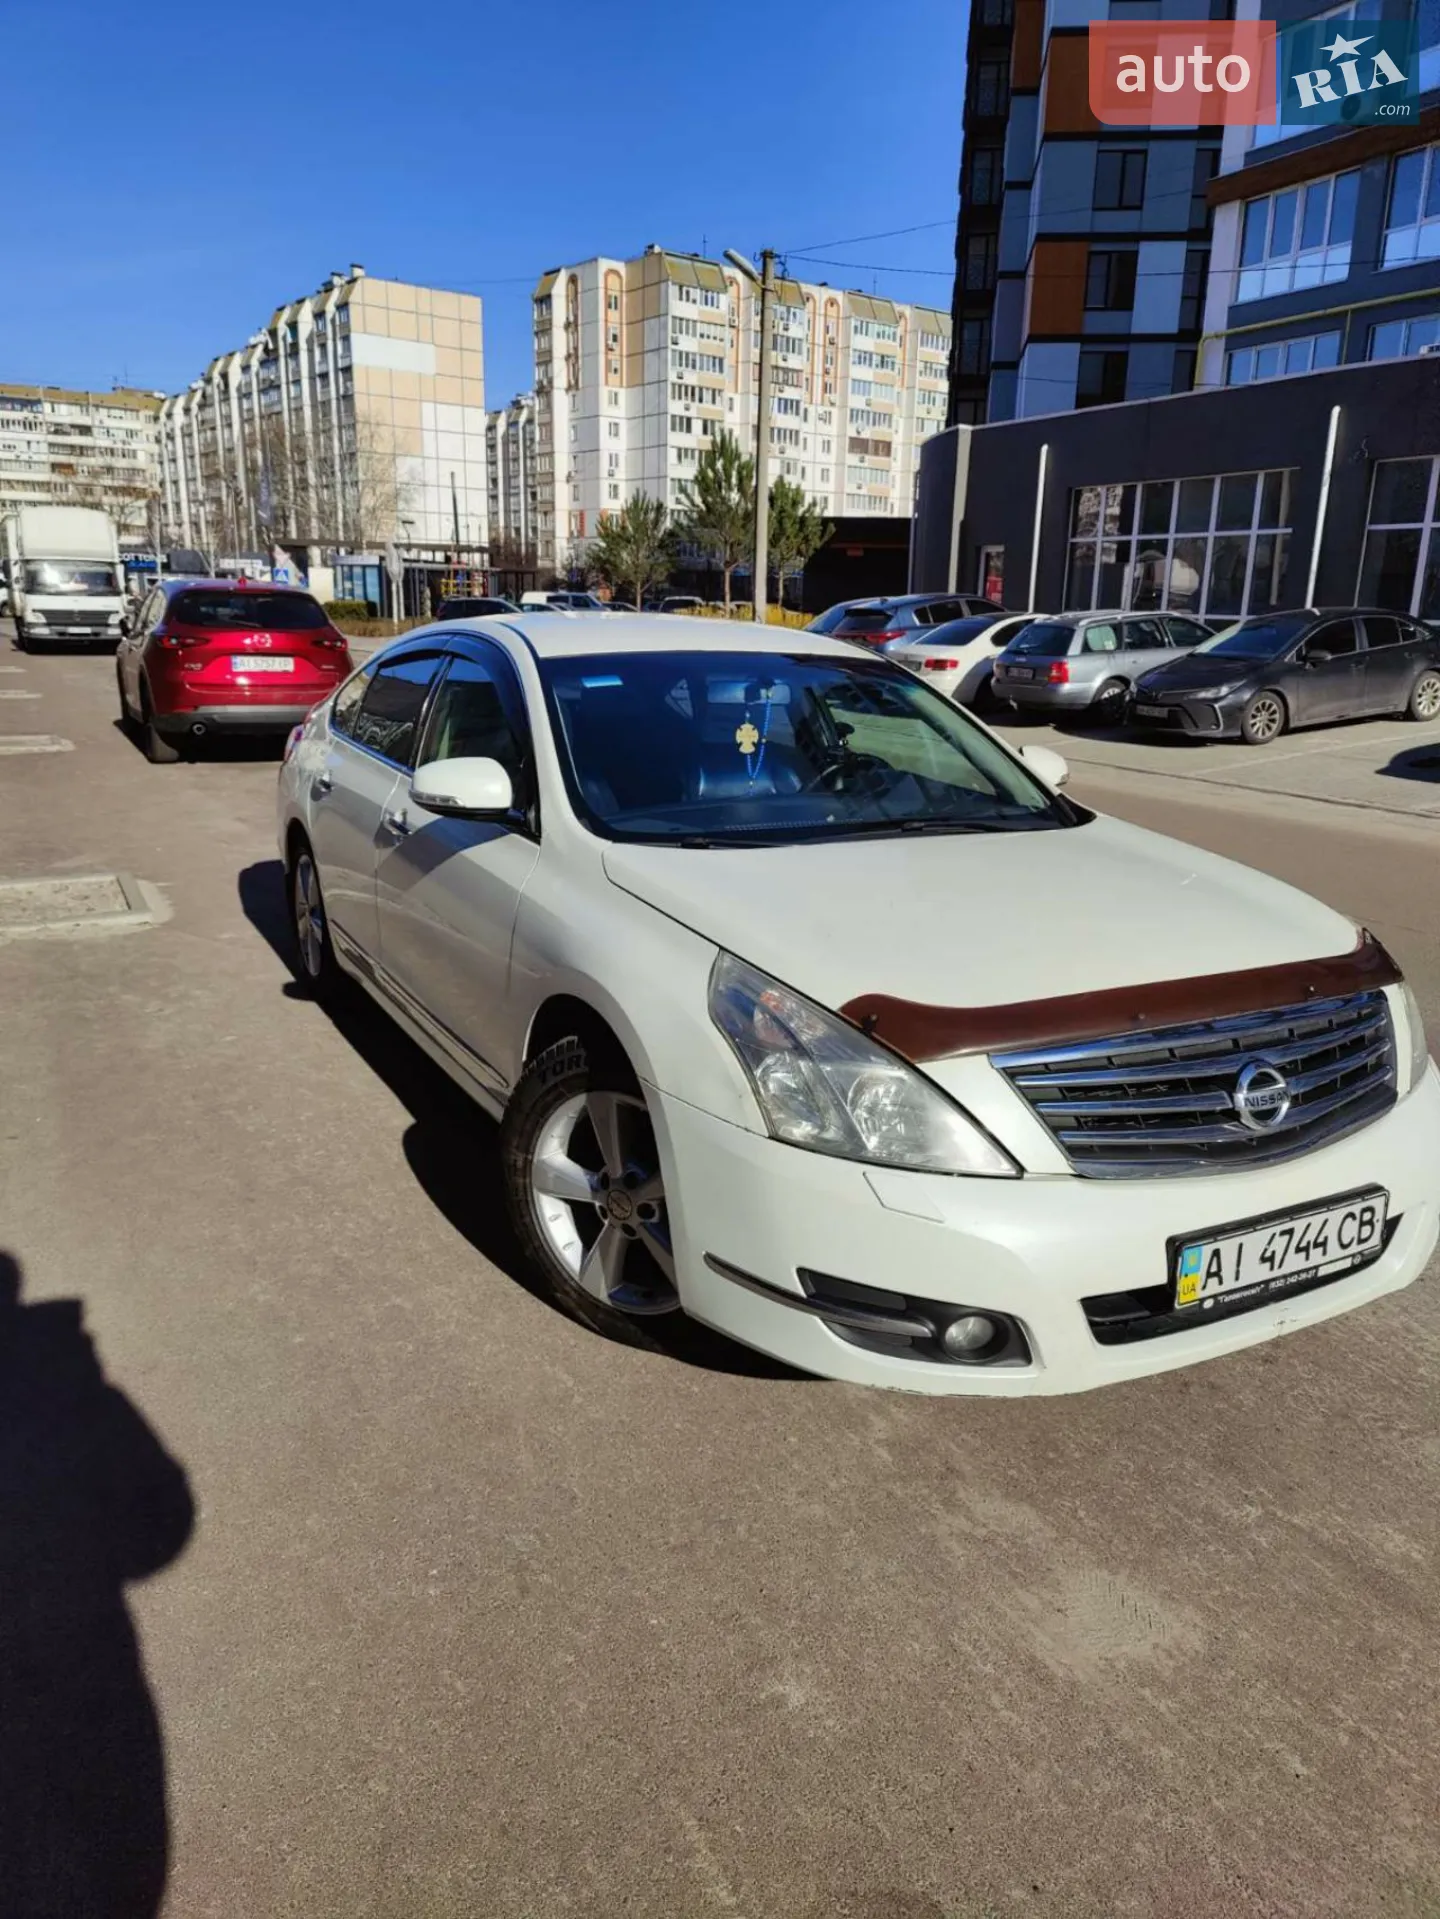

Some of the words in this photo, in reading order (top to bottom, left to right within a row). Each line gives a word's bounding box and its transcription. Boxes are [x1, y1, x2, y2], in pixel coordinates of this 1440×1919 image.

[1244, 1089, 1289, 1108] NISSAN
[1201, 1242, 1244, 1290] AI
[1259, 1217, 1329, 1272] 4744
[1337, 1205, 1377, 1251] CB
[1181, 1281, 1197, 1296] UA
